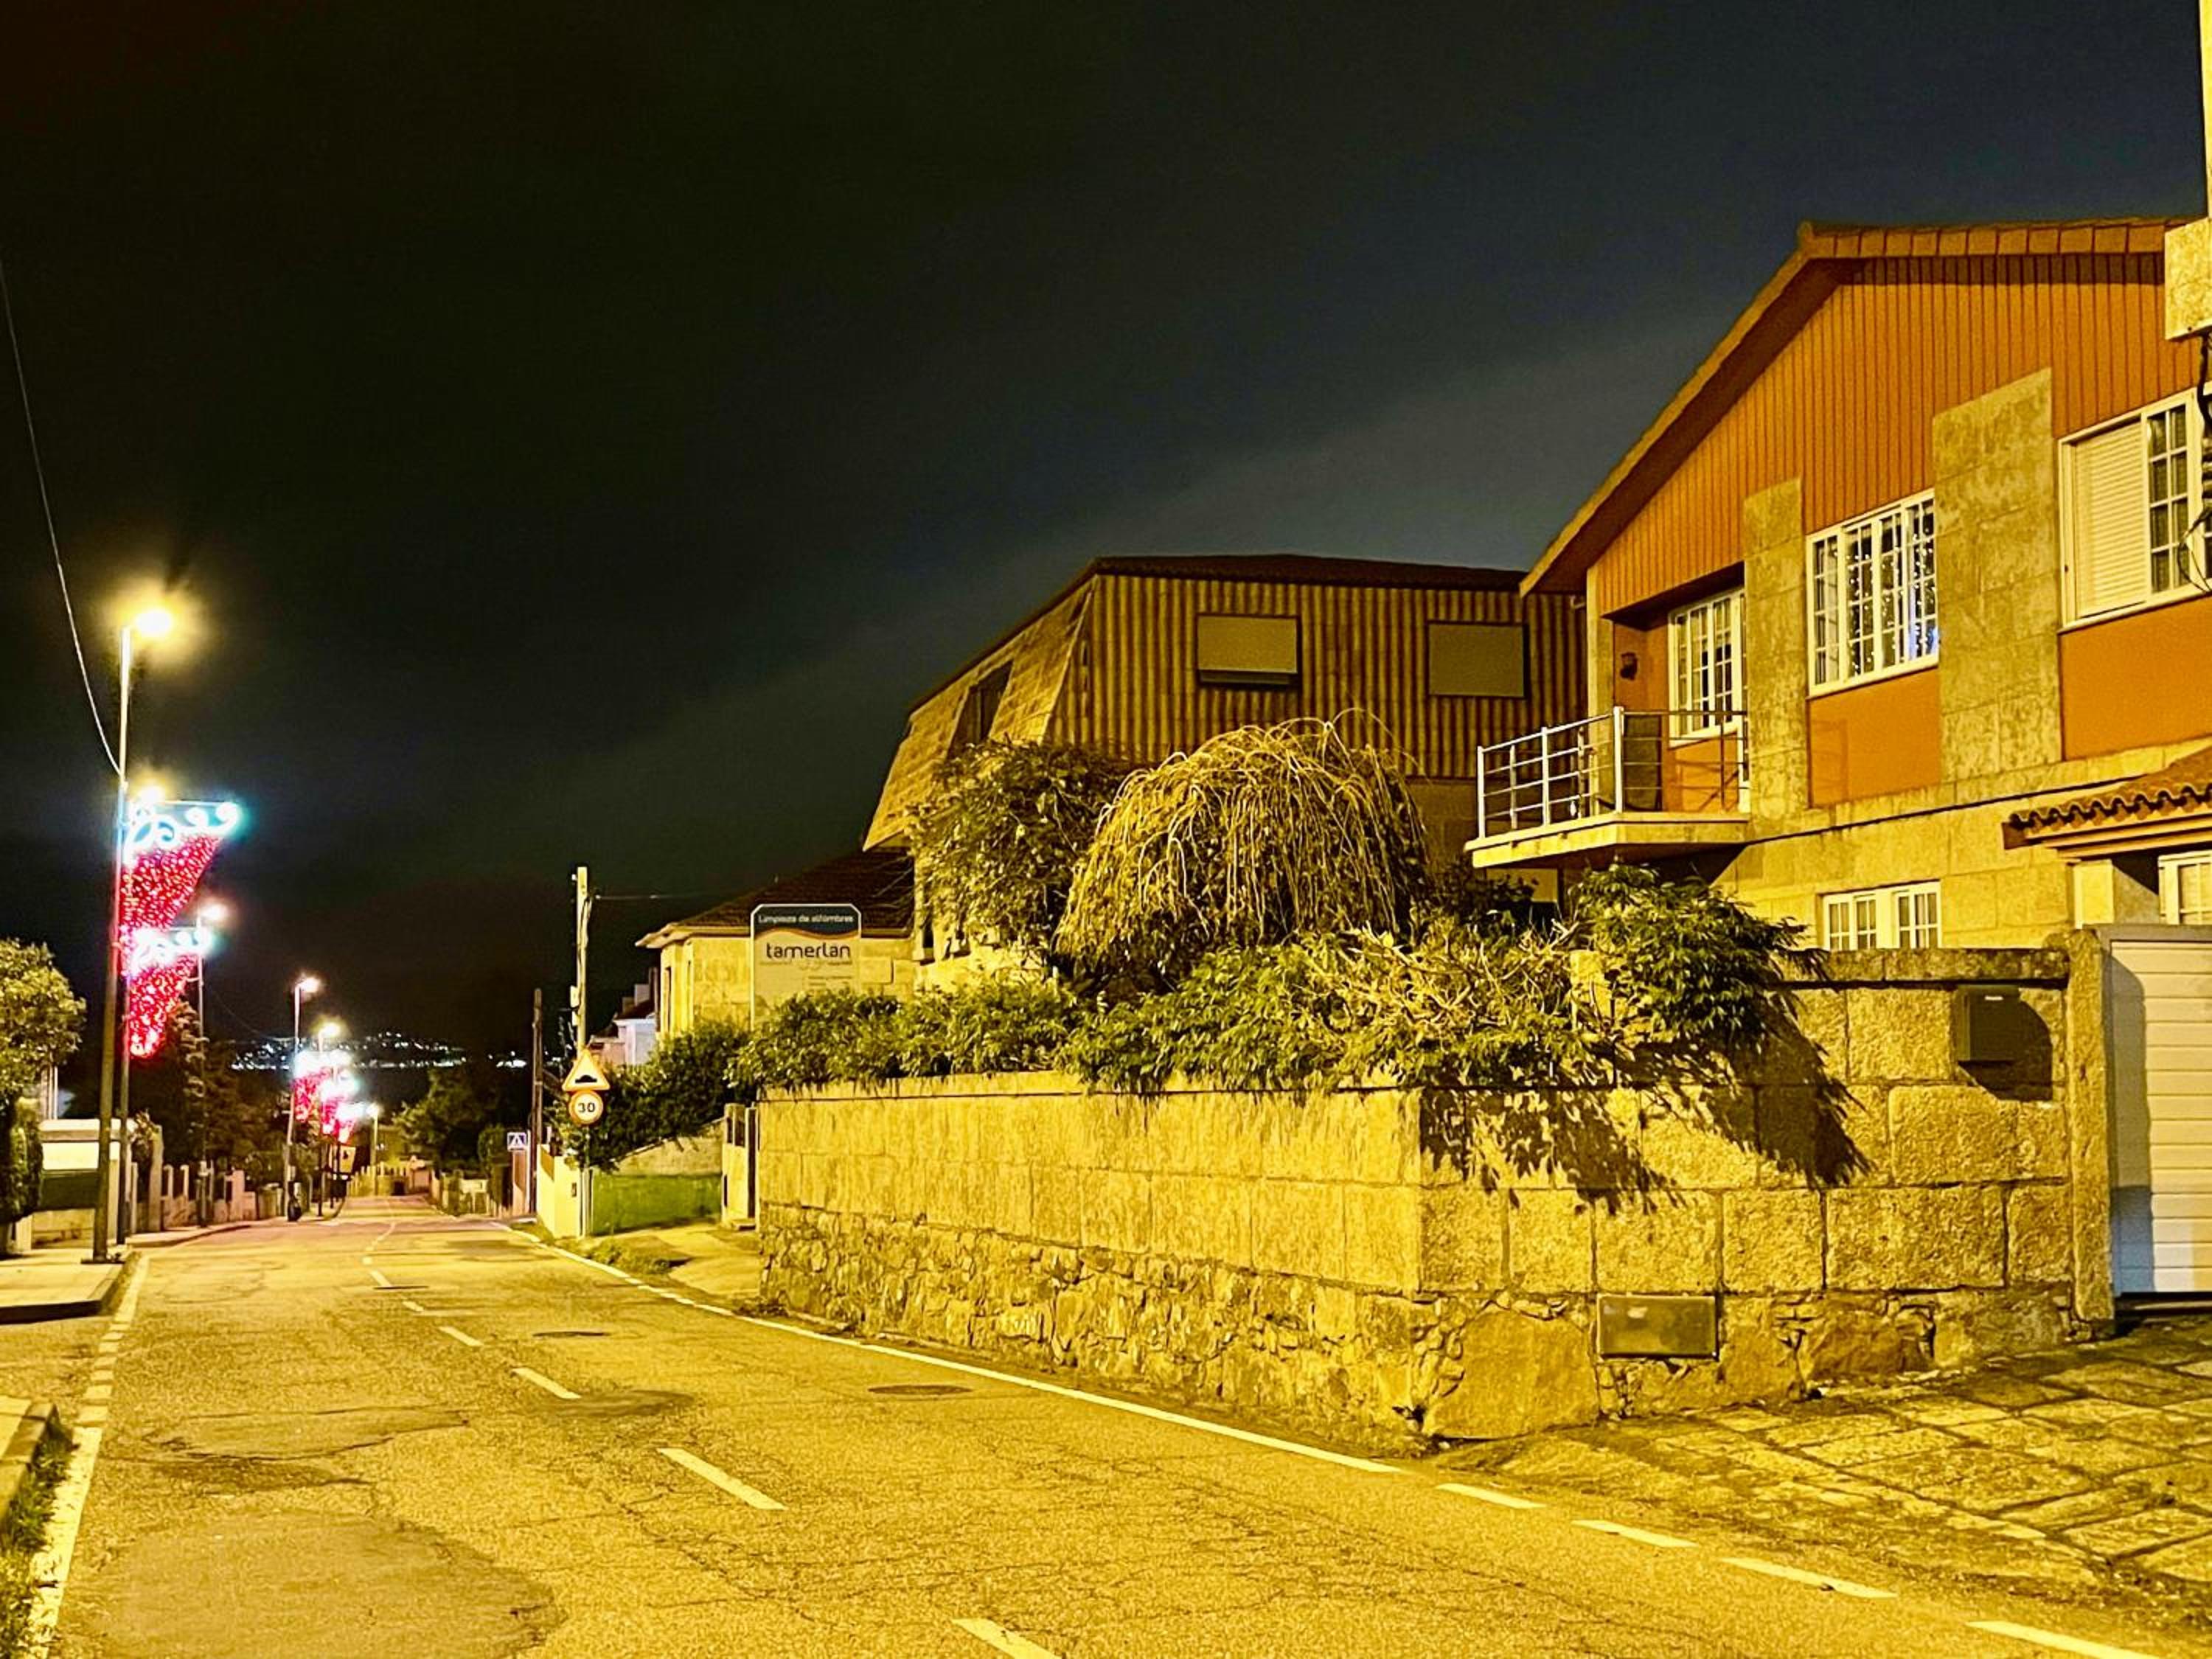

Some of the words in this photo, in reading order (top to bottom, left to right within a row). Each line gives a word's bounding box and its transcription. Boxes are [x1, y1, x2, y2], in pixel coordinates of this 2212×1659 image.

[799, 914, 810, 922] de
[766, 942, 850, 958] tamerlan
[577, 1102, 596, 1113] 30
